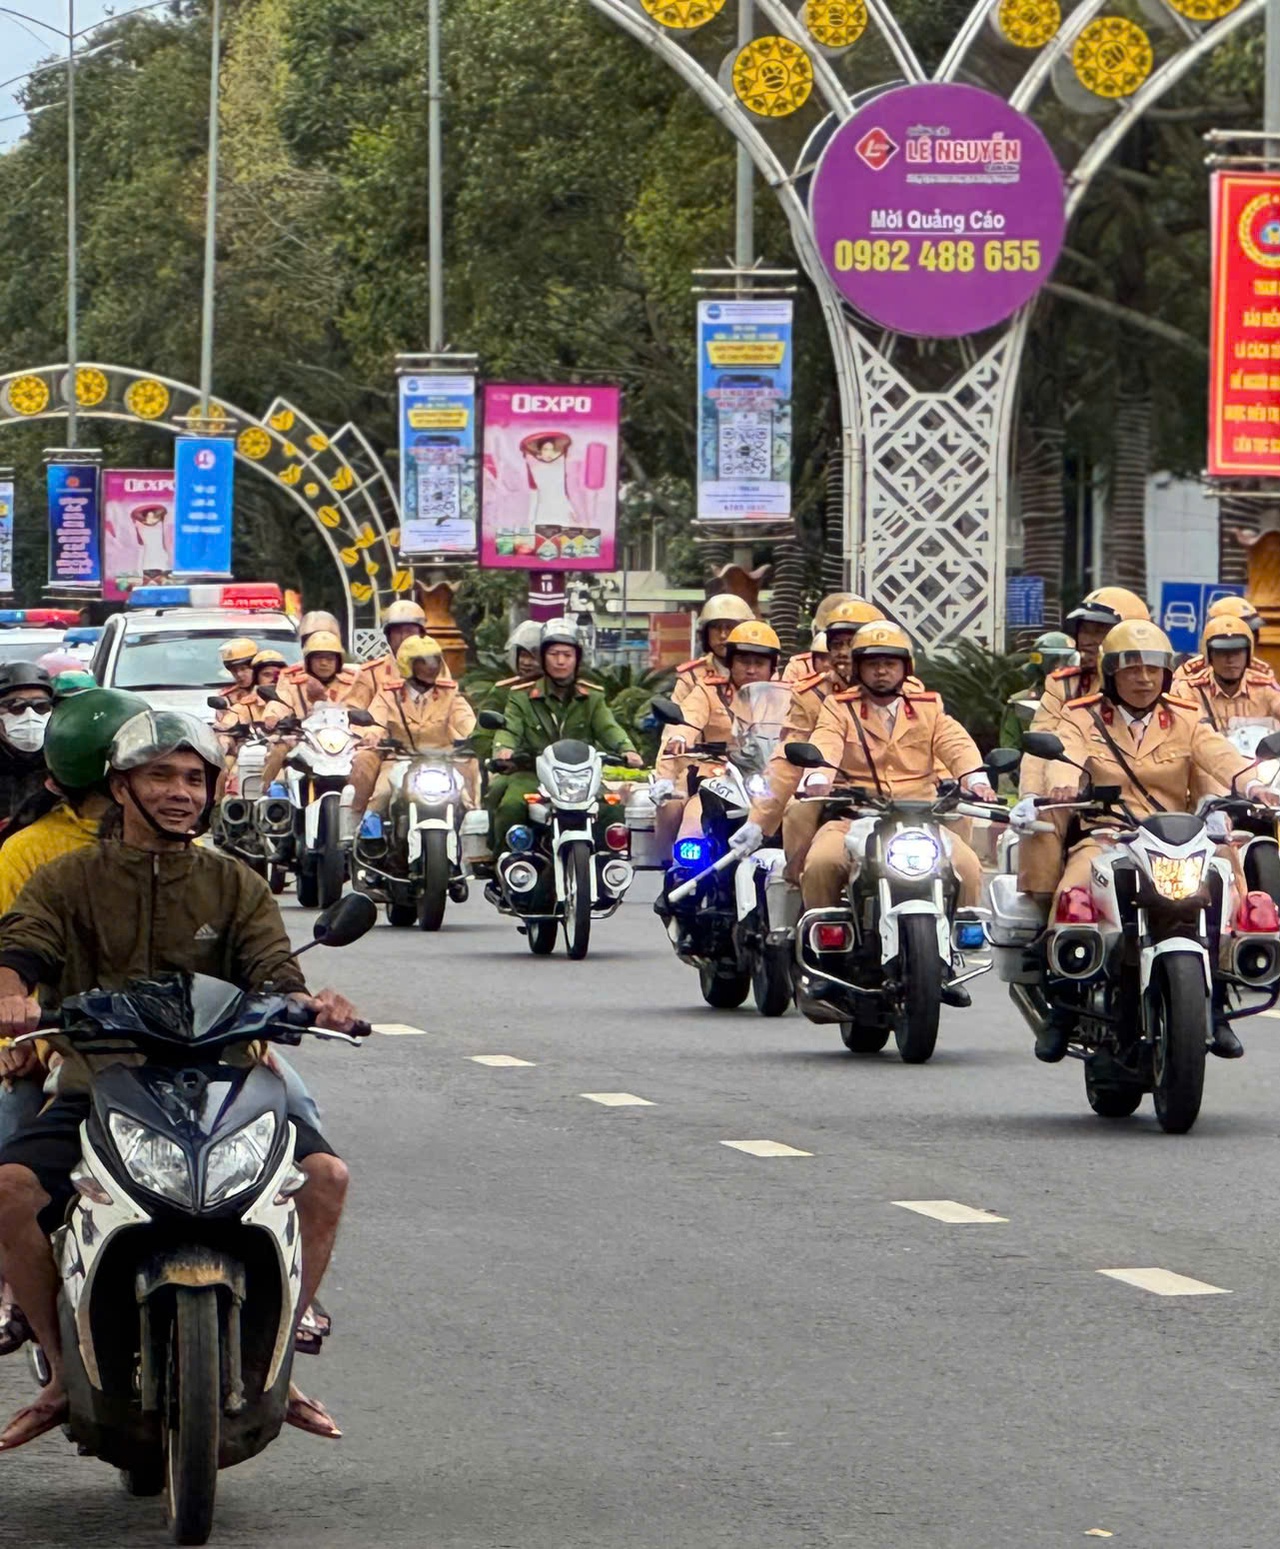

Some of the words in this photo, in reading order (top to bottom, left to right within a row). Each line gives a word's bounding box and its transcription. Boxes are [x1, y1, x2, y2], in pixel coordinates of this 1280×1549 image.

[906, 135, 932, 163] LÊ
[870, 209, 903, 229] Mời
[907, 208, 965, 233] Quảng
[969, 210, 1005, 229] Cáo
[834, 239, 910, 272] 0982
[918, 239, 975, 272] 488
[984, 239, 1041, 272] 655
[512, 393, 592, 413] OEXPO
[124, 478, 175, 492] OEXP
